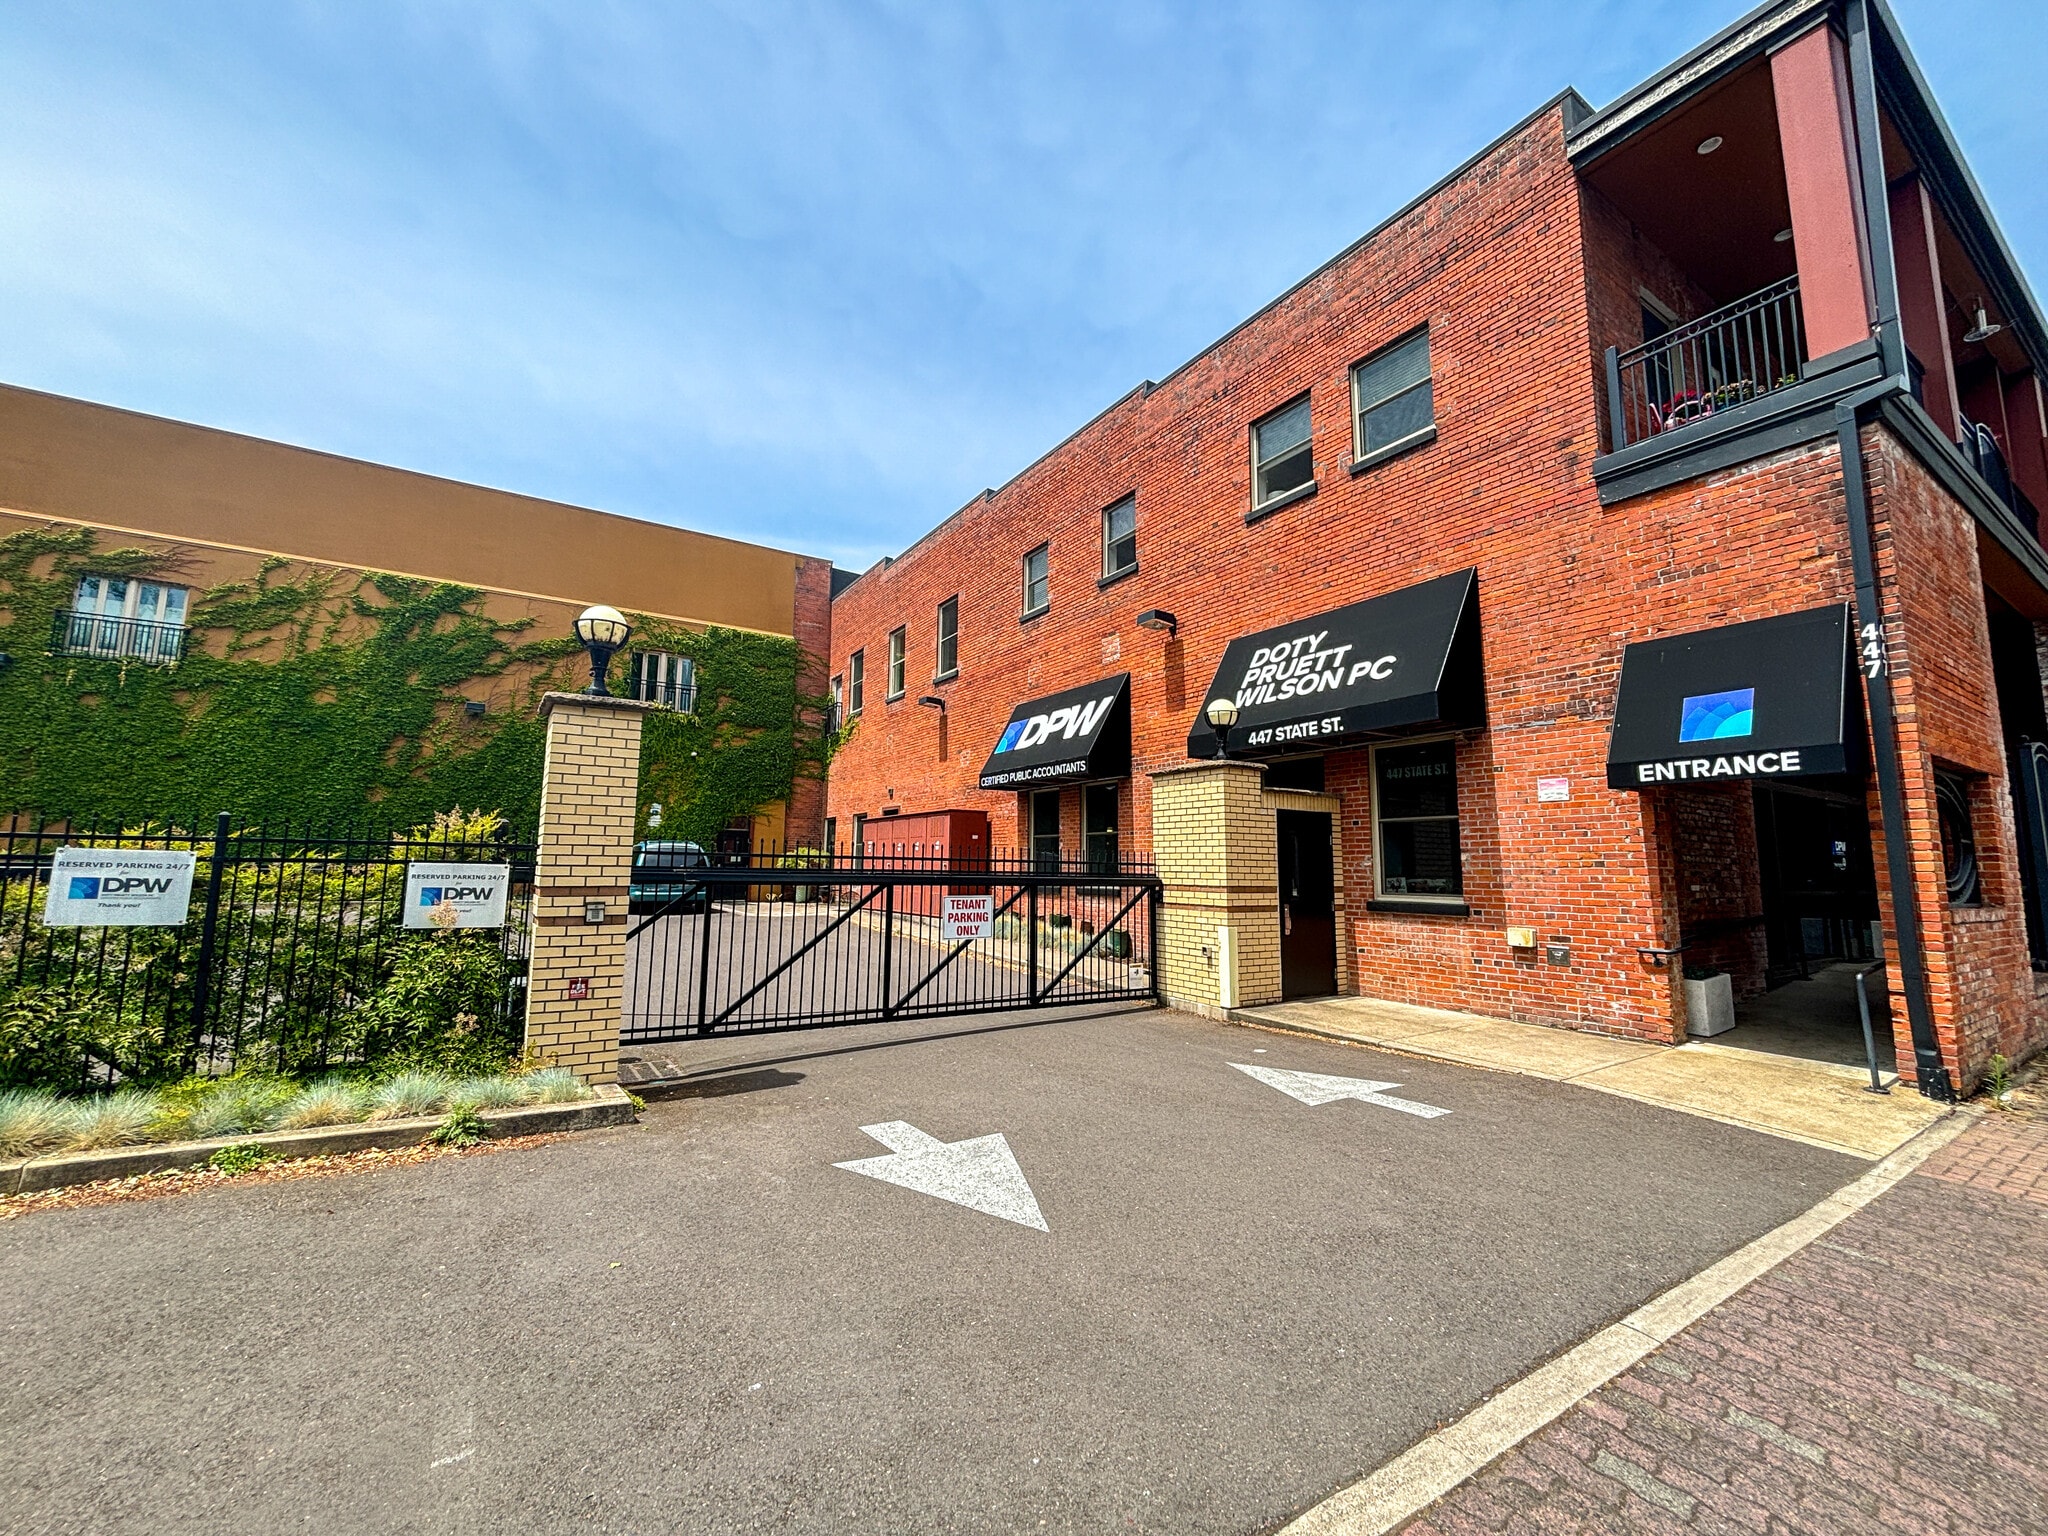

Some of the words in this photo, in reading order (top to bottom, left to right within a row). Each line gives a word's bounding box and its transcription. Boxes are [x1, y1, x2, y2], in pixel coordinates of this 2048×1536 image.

[1250, 630, 1328, 669] DOTY
[1861, 623, 1880, 678] 447
[1241, 645, 1352, 688] PRUETT
[1235, 667, 1346, 709] WILSON
[1346, 655, 1397, 685] PC
[1014, 696, 1114, 751] DPW
[1248, 729, 1272, 746] 447
[1277, 720, 1317, 741] STATE
[1319, 717, 1344, 734] ST.
[981, 775, 1008, 787] CERTIFIED
[1009, 768, 1032, 782] PUBLIC
[1032, 761, 1086, 779] ACCOUNTANTS
[1386, 768, 1402, 779] 447
[1405, 765, 1432, 778] STATE
[1434, 763, 1449, 775] ST.
[1638, 751, 1801, 782] ENTRANCE
[102, 877, 173, 893] DPW
[444, 887, 494, 900] DPW
[948, 912, 989, 923] PARKING
[950, 899, 987, 910] TENANT
[956, 925, 980, 936] ONLY
